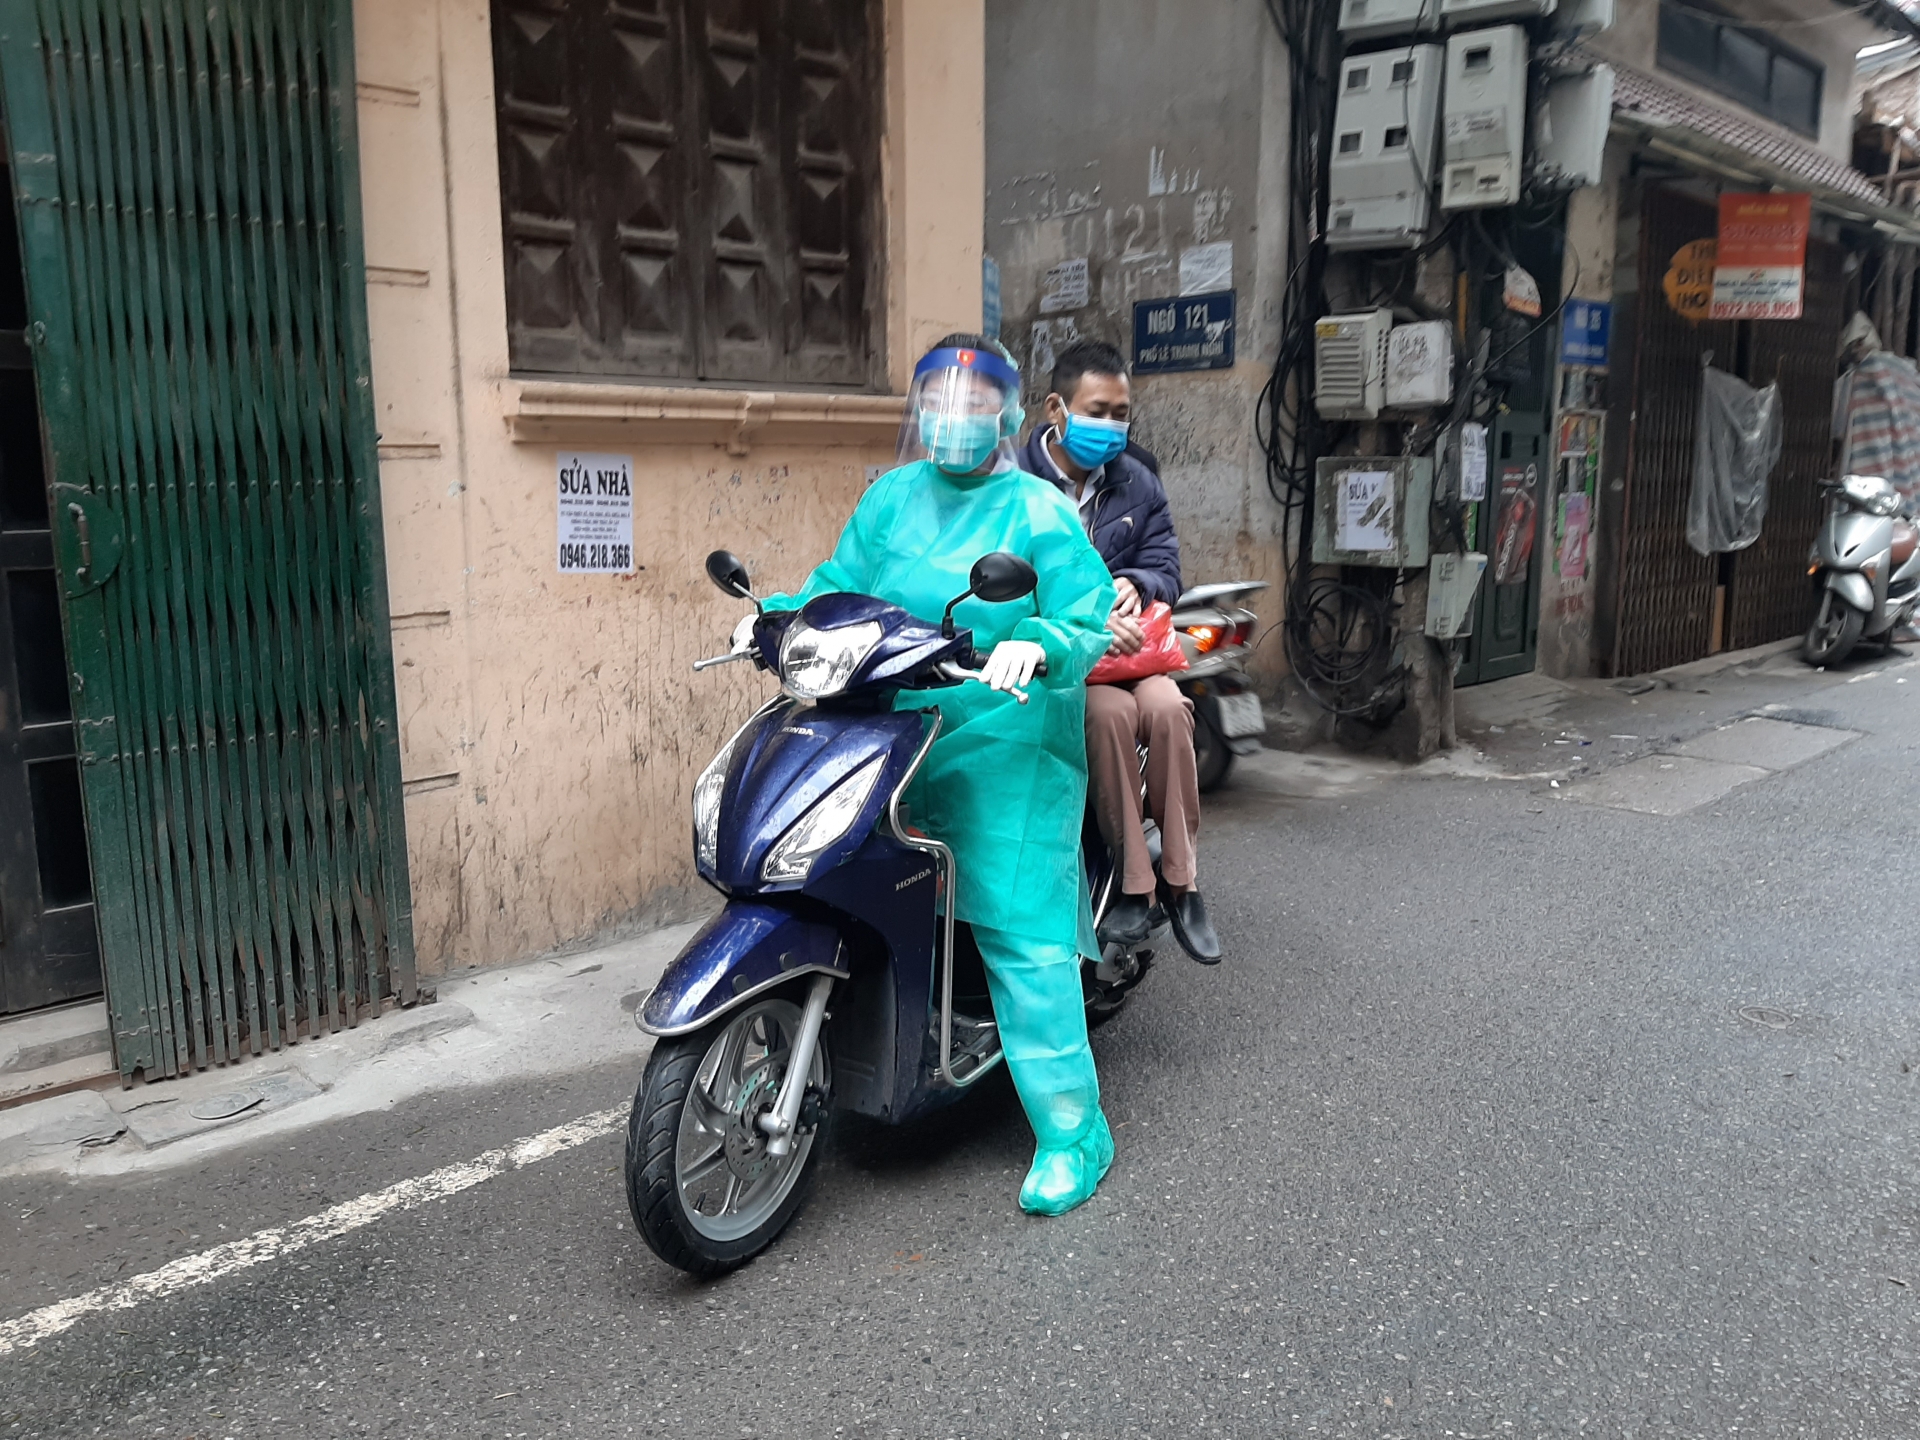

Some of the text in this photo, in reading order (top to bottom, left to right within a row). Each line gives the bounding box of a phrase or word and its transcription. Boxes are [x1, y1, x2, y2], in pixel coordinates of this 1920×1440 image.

[1184, 303, 1209, 331] 121
[560, 457, 631, 496] SỬA NHÀ
[1349, 476, 1369, 500] SỬA
[560, 543, 630, 569] 0946.218.366
[781, 726, 814, 736] HONDA
[895, 868, 932, 891] HONDA
